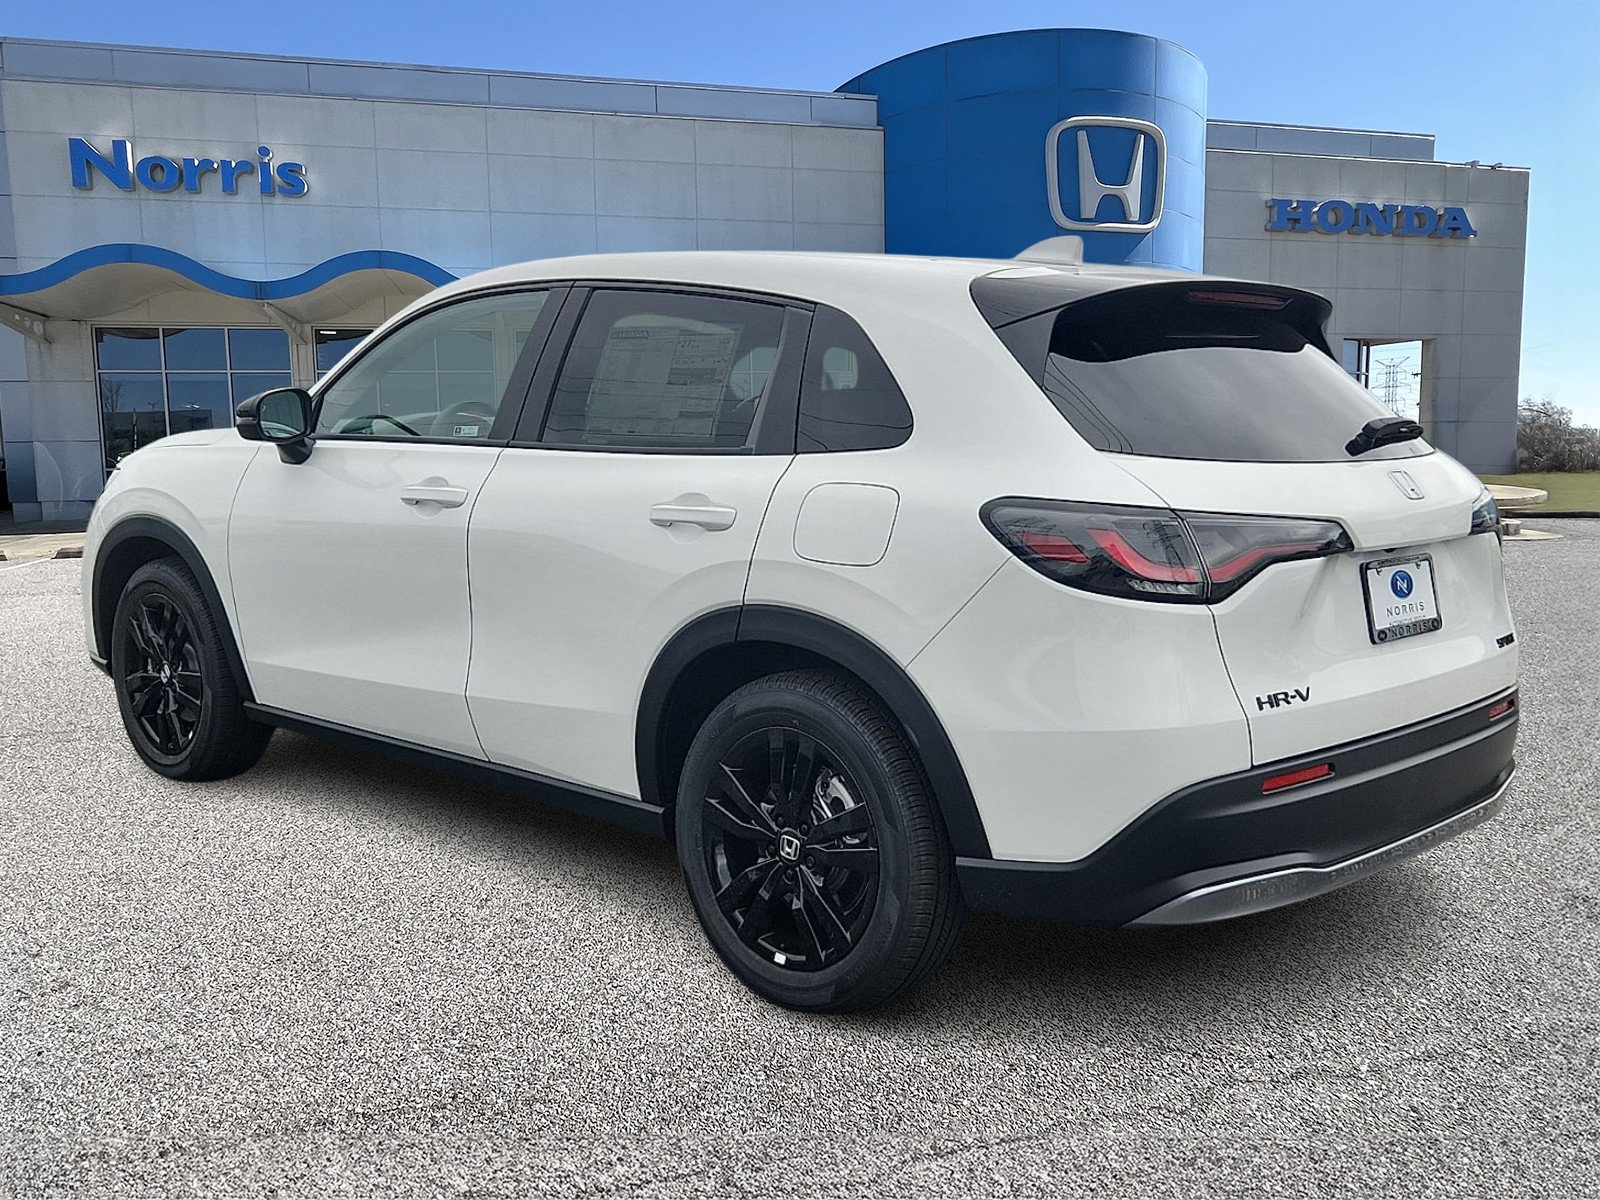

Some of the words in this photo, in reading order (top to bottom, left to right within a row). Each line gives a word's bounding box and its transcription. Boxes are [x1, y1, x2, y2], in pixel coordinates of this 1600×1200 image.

[68, 136, 309, 197] Norris
[1266, 198, 1478, 238] HONDA
[1386, 601, 1425, 617] NORRIS
[1388, 621, 1430, 639] NORRIS
[1255, 686, 1310, 711] HR-V
